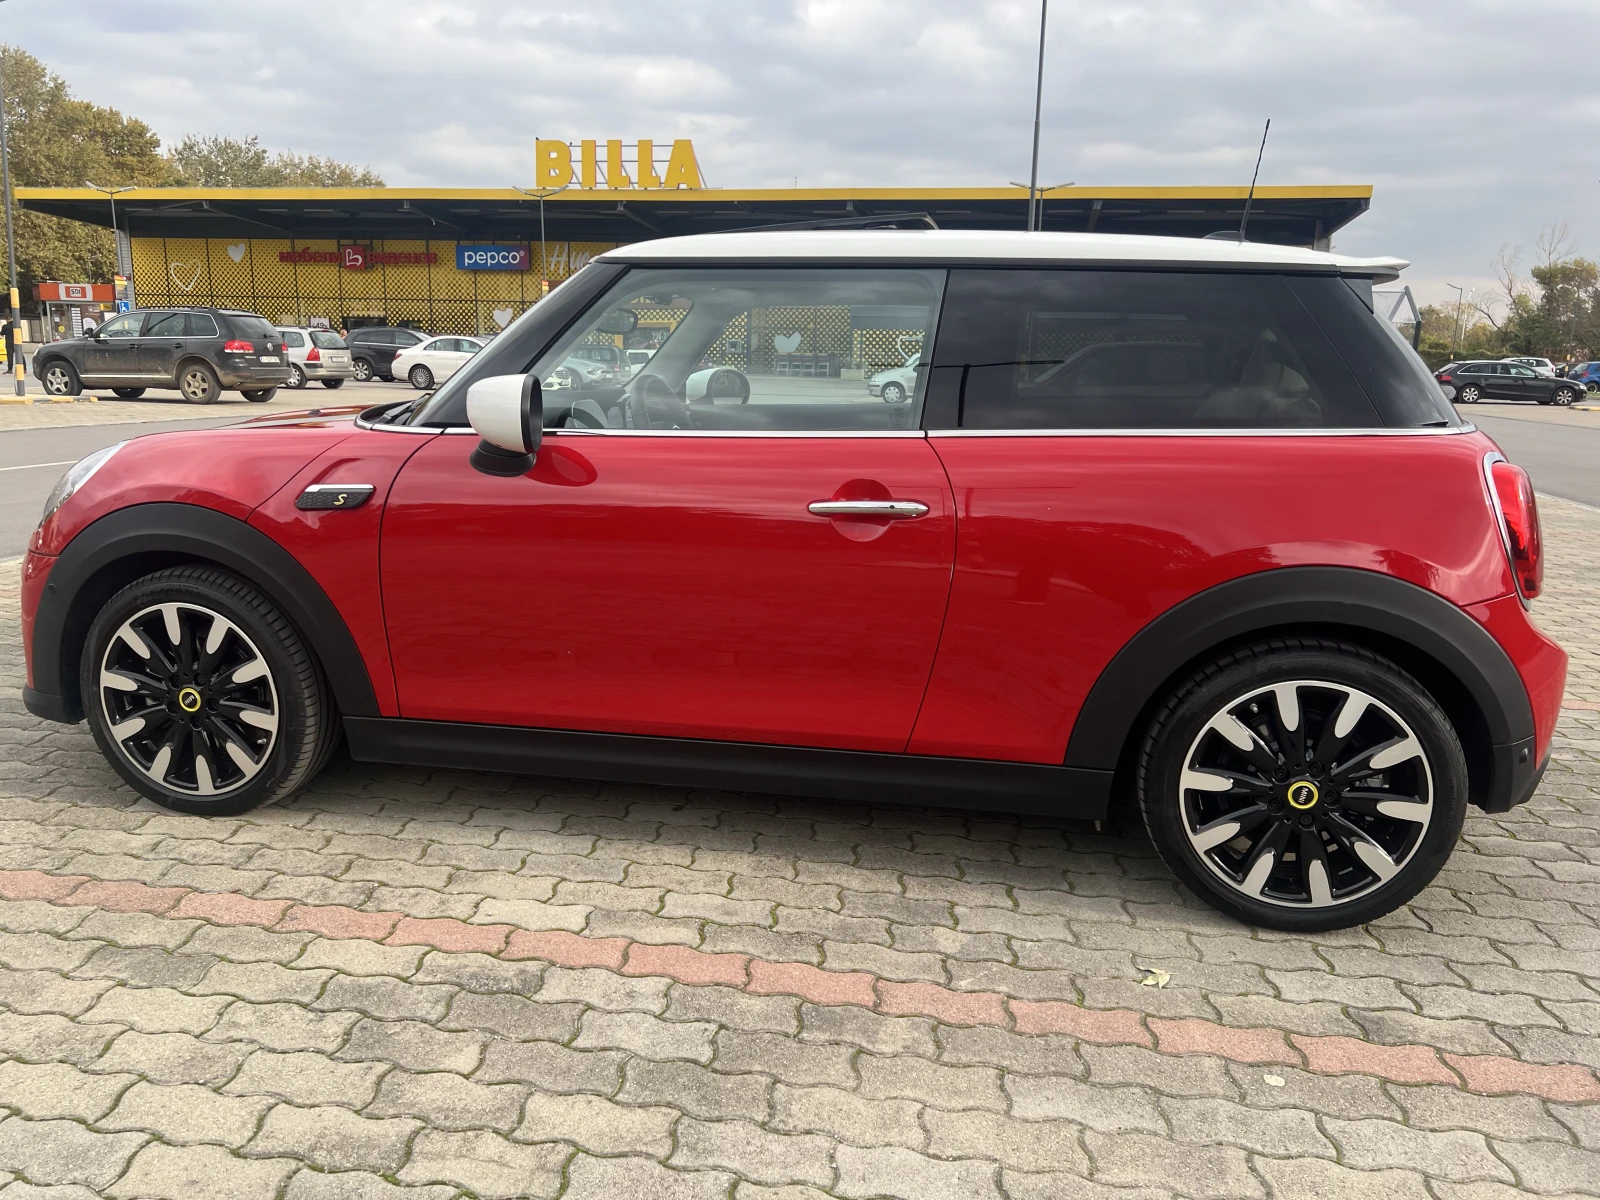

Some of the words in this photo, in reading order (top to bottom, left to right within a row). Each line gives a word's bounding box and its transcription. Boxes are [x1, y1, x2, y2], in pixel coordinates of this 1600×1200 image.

[536, 139, 702, 189] BILLA
[464, 251, 520, 266] pepco
[333, 493, 348, 506] S
[1297, 787, 1309, 804] MINI
